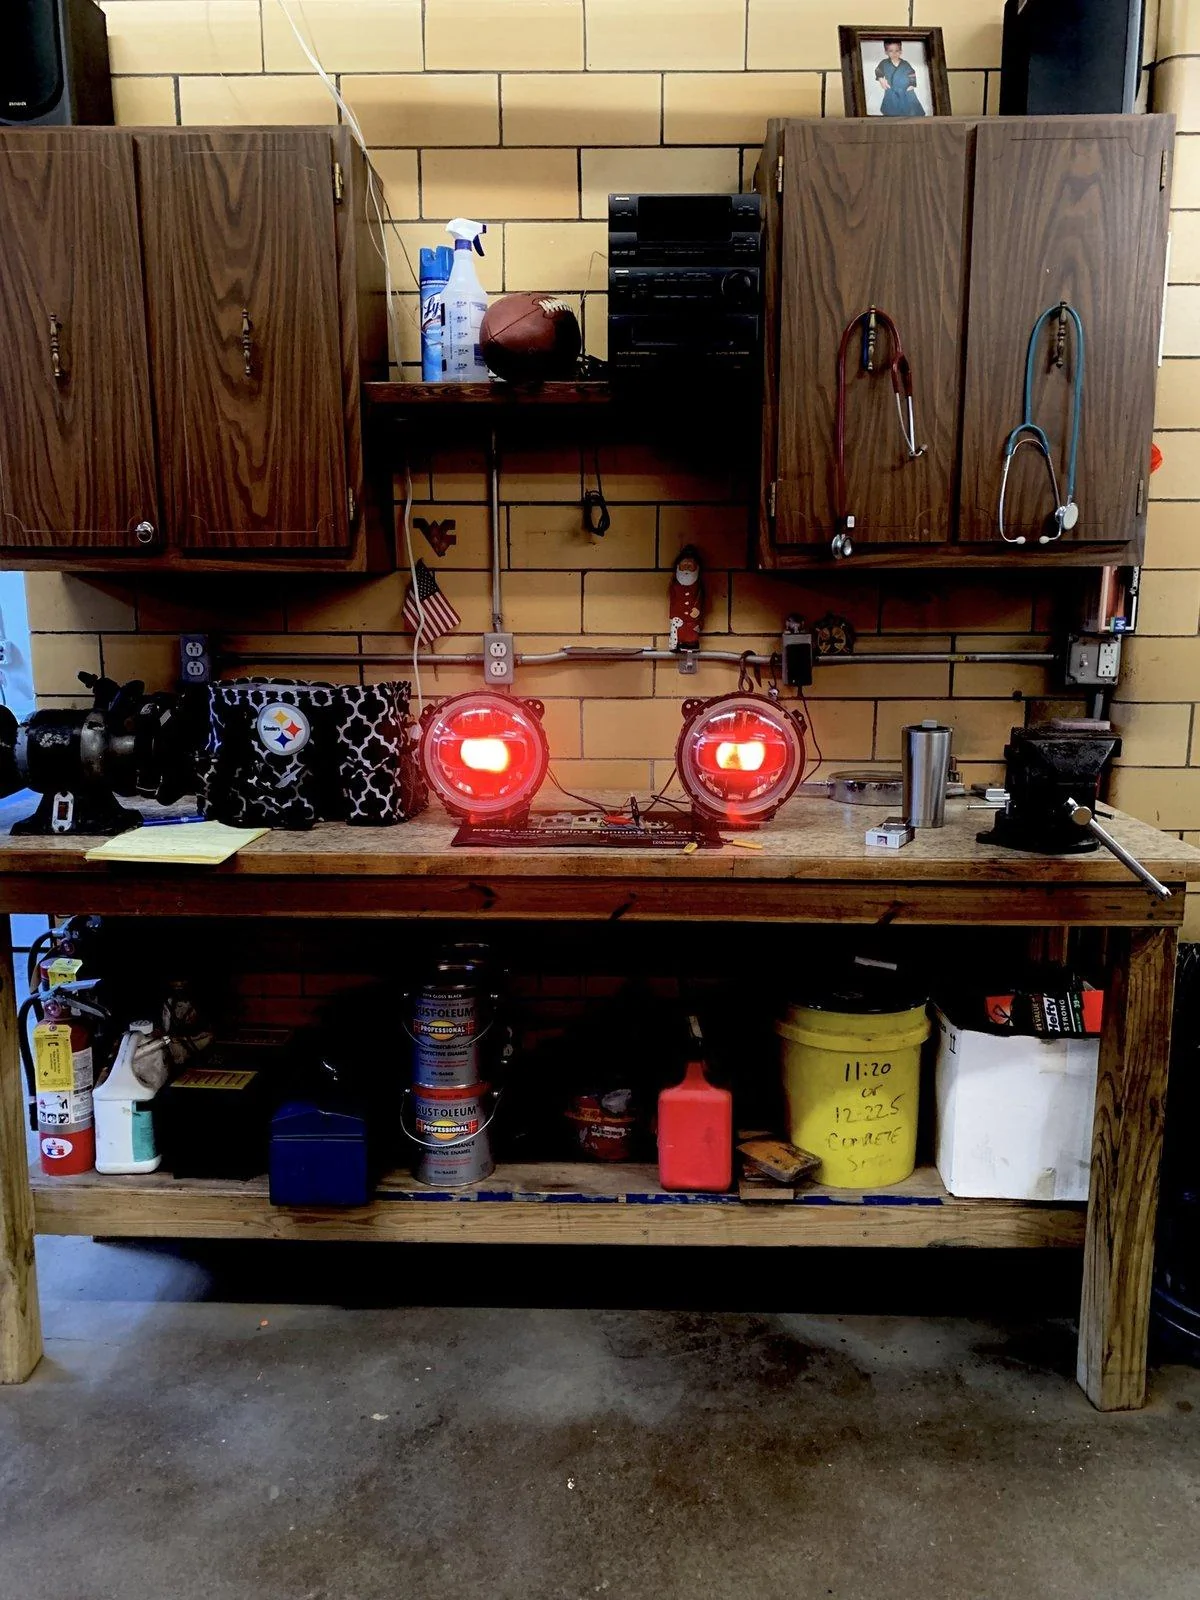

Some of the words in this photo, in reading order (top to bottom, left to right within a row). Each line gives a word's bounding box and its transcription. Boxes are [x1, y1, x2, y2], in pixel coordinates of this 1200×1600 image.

[1045, 998, 1060, 1032] Hefty
[1058, 999, 1070, 1032] STRONG
[420, 1024, 466, 1034] PROFESSIONAL
[845, 1061, 892, 1082] 11:20
[861, 1084, 883, 1098] or
[423, 1123, 468, 1133] PROFESSIONAL
